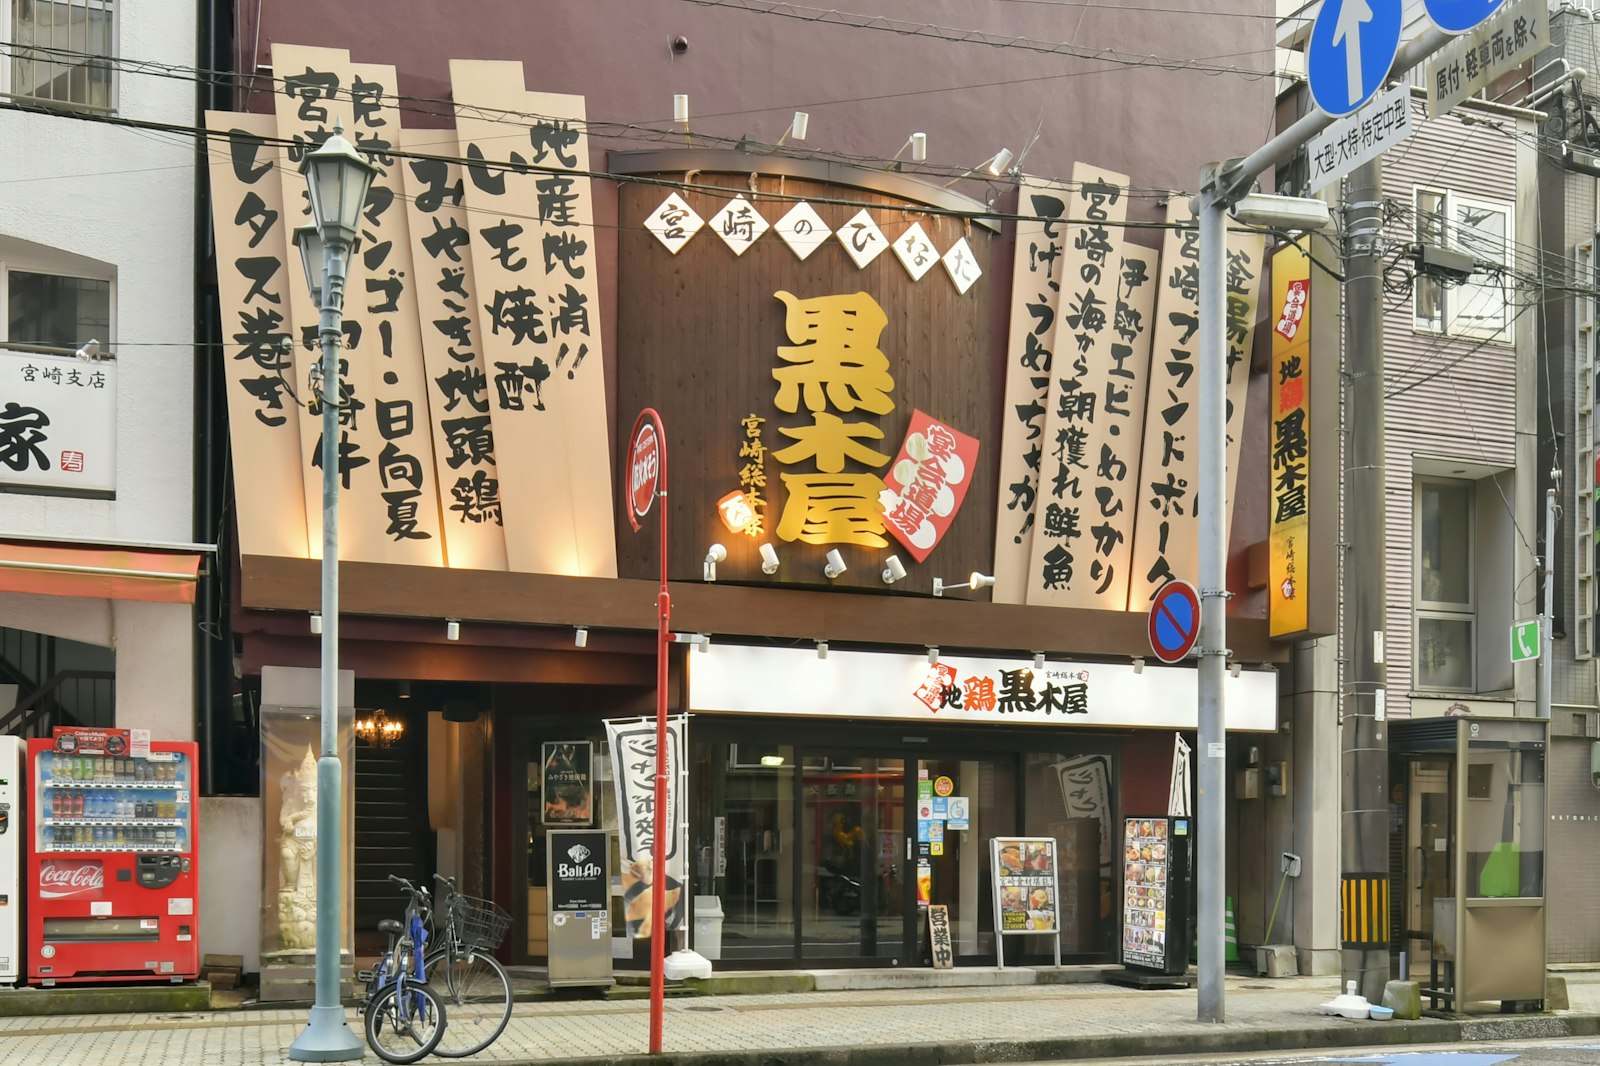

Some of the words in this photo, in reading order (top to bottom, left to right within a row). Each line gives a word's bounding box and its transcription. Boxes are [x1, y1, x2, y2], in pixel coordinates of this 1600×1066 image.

[1436, 15, 1538, 101] 原付・軽車両を除く
[1314, 98, 1406, 180] 大型・大特・特定中型
[228, 127, 294, 428] レタス巻き
[20, 363, 107, 389] 宮崎支店
[407, 159, 504, 527] みやざき地頭鶏
[1041, 176, 1121, 592] 宮崎の海から朝獲れ鮮魚
[771, 289, 896, 549] 黒木屋
[40, 864, 104, 889] Coca-Cola
[930, 907, 952, 967] 営業中
